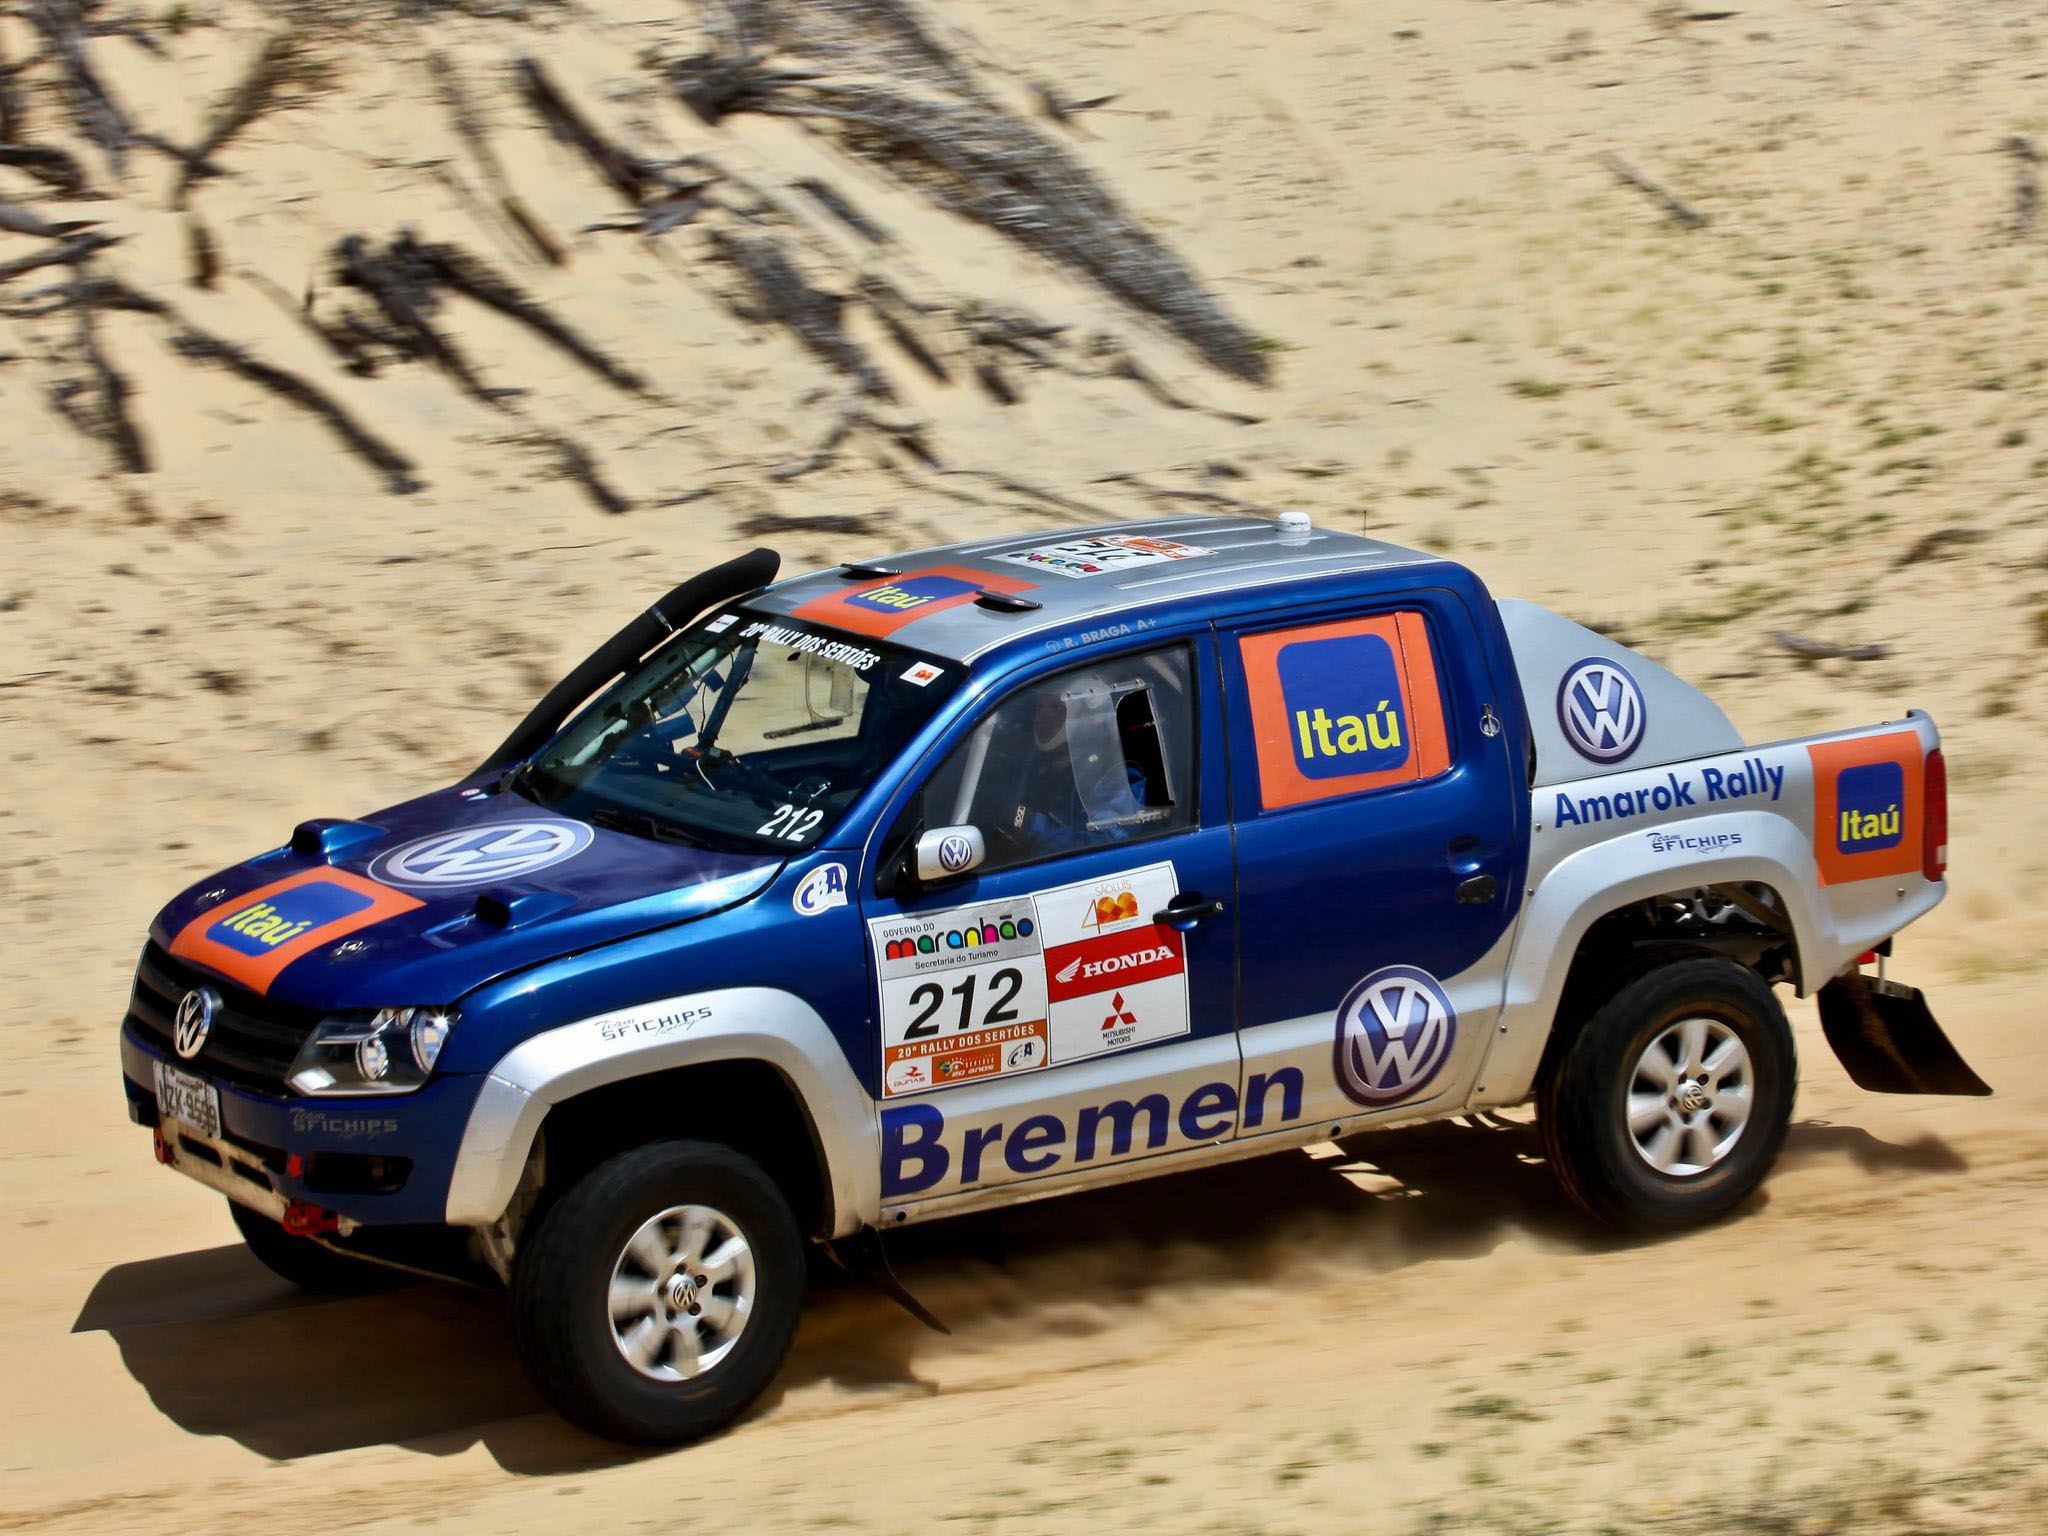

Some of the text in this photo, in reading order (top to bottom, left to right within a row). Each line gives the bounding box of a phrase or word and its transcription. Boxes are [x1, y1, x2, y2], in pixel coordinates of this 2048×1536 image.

[857, 586, 935, 609] Itaú
[759, 626, 803, 646] RALLY
[792, 634, 827, 653] DOS
[817, 641, 881, 670] SERTÕES
[1063, 618, 1157, 648] R. BRAGA A+
[1295, 699, 1402, 759] Itaú
[1555, 757, 1784, 828] Amarok Rally
[756, 804, 824, 842] 212
[1839, 803, 1900, 842] Itaú
[222, 902, 313, 946] Itaú
[883, 923, 935, 938] GOVERNO DO
[885, 914, 1034, 960] maranhão
[915, 950, 999, 970] Secretaria do Turismo
[1082, 945, 1175, 979] HONDA
[903, 967, 1023, 1040] 212
[898, 1024, 1035, 1058] 20º RALLY DOS SERTÕES
[1102, 1026, 1136, 1040] MITSUBISHI
[1107, 1035, 1131, 1047] MOTORS
[880, 1066, 1304, 1198] Bremen
